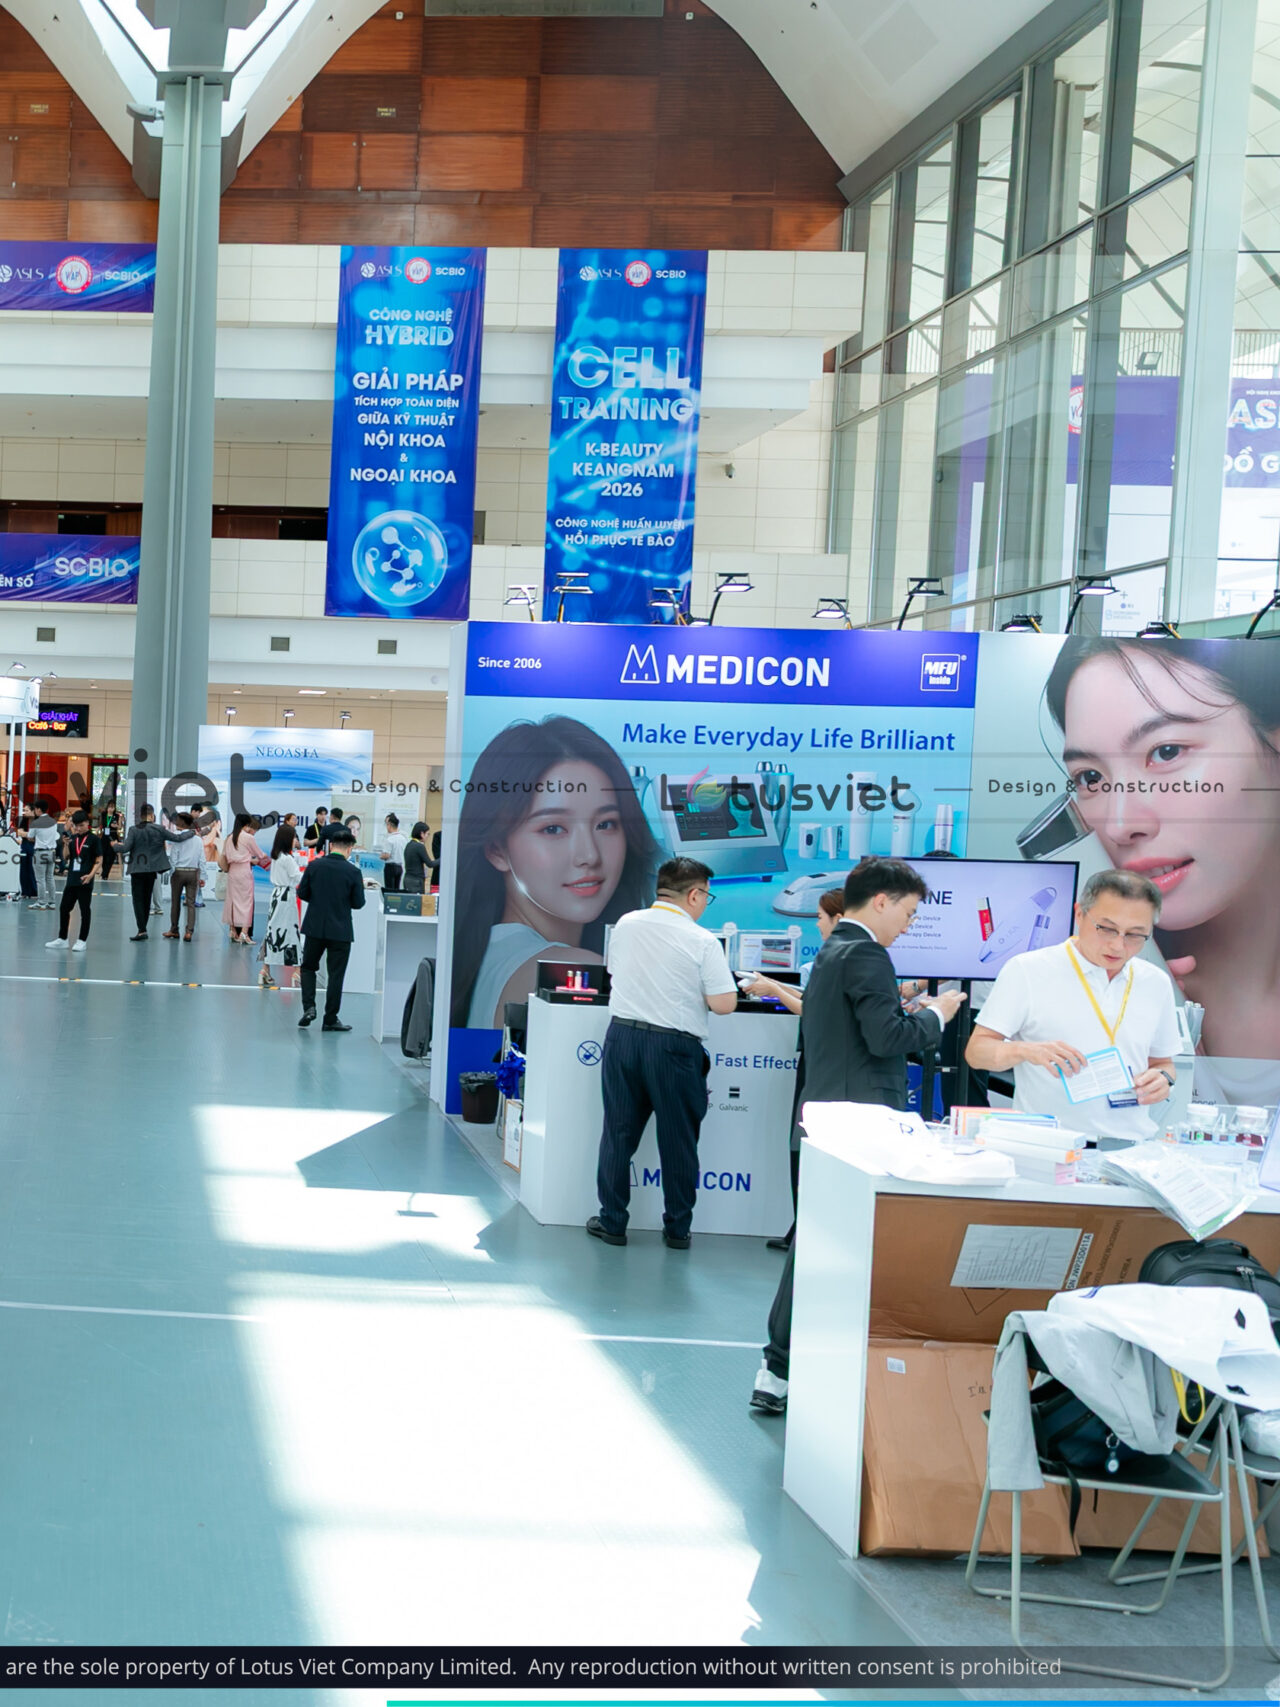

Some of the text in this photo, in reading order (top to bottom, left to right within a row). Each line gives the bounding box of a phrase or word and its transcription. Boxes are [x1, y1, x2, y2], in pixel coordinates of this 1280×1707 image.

[104, 271, 140, 281] SCBIO
[435, 267, 466, 276] SCBIO
[655, 270, 687, 279] SCBIO
[369, 307, 454, 325] CÔNG NGHỆ
[365, 324, 454, 346] HYBRID
[567, 345, 691, 390] CELL
[352, 366, 464, 391] GIẢI PHÁP
[354, 395, 459, 410] TÍCH HỢP TOÀN DIỆN
[559, 396, 694, 422] TRAINING
[357, 411, 455, 429] GIỮA KỸ THUẬT
[364, 429, 446, 450] NỘI KHOA
[585, 442, 664, 457] K-BEAUTY
[350, 468, 457, 486] NGOẠI KHOA
[572, 462, 674, 478] KEANGNAM
[601, 482, 644, 497] 2026
[555, 517, 588, 528] CÔNG
[591, 517, 620, 531] NGHỆ
[622, 517, 652, 529] HUẤN
[565, 530, 588, 545] HỒI
[591, 534, 627, 548] PHỤC
[647, 535, 675, 547] BÀO
[53, 556, 130, 578] SCBIO
[16, 573, 34, 588] SỐ
[477, 656, 542, 670] Since 2006
[665, 654, 830, 688] MEDICON
[923, 661, 958, 676] MFU
[53, 722, 67, 731] Bar
[622, 723, 956, 753] Make Everyday Life Brilliant
[256, 746, 320, 759] NEOASIA
[715, 1053, 798, 1070] Fast Effect
[719, 1103, 749, 1113] Galvanic
